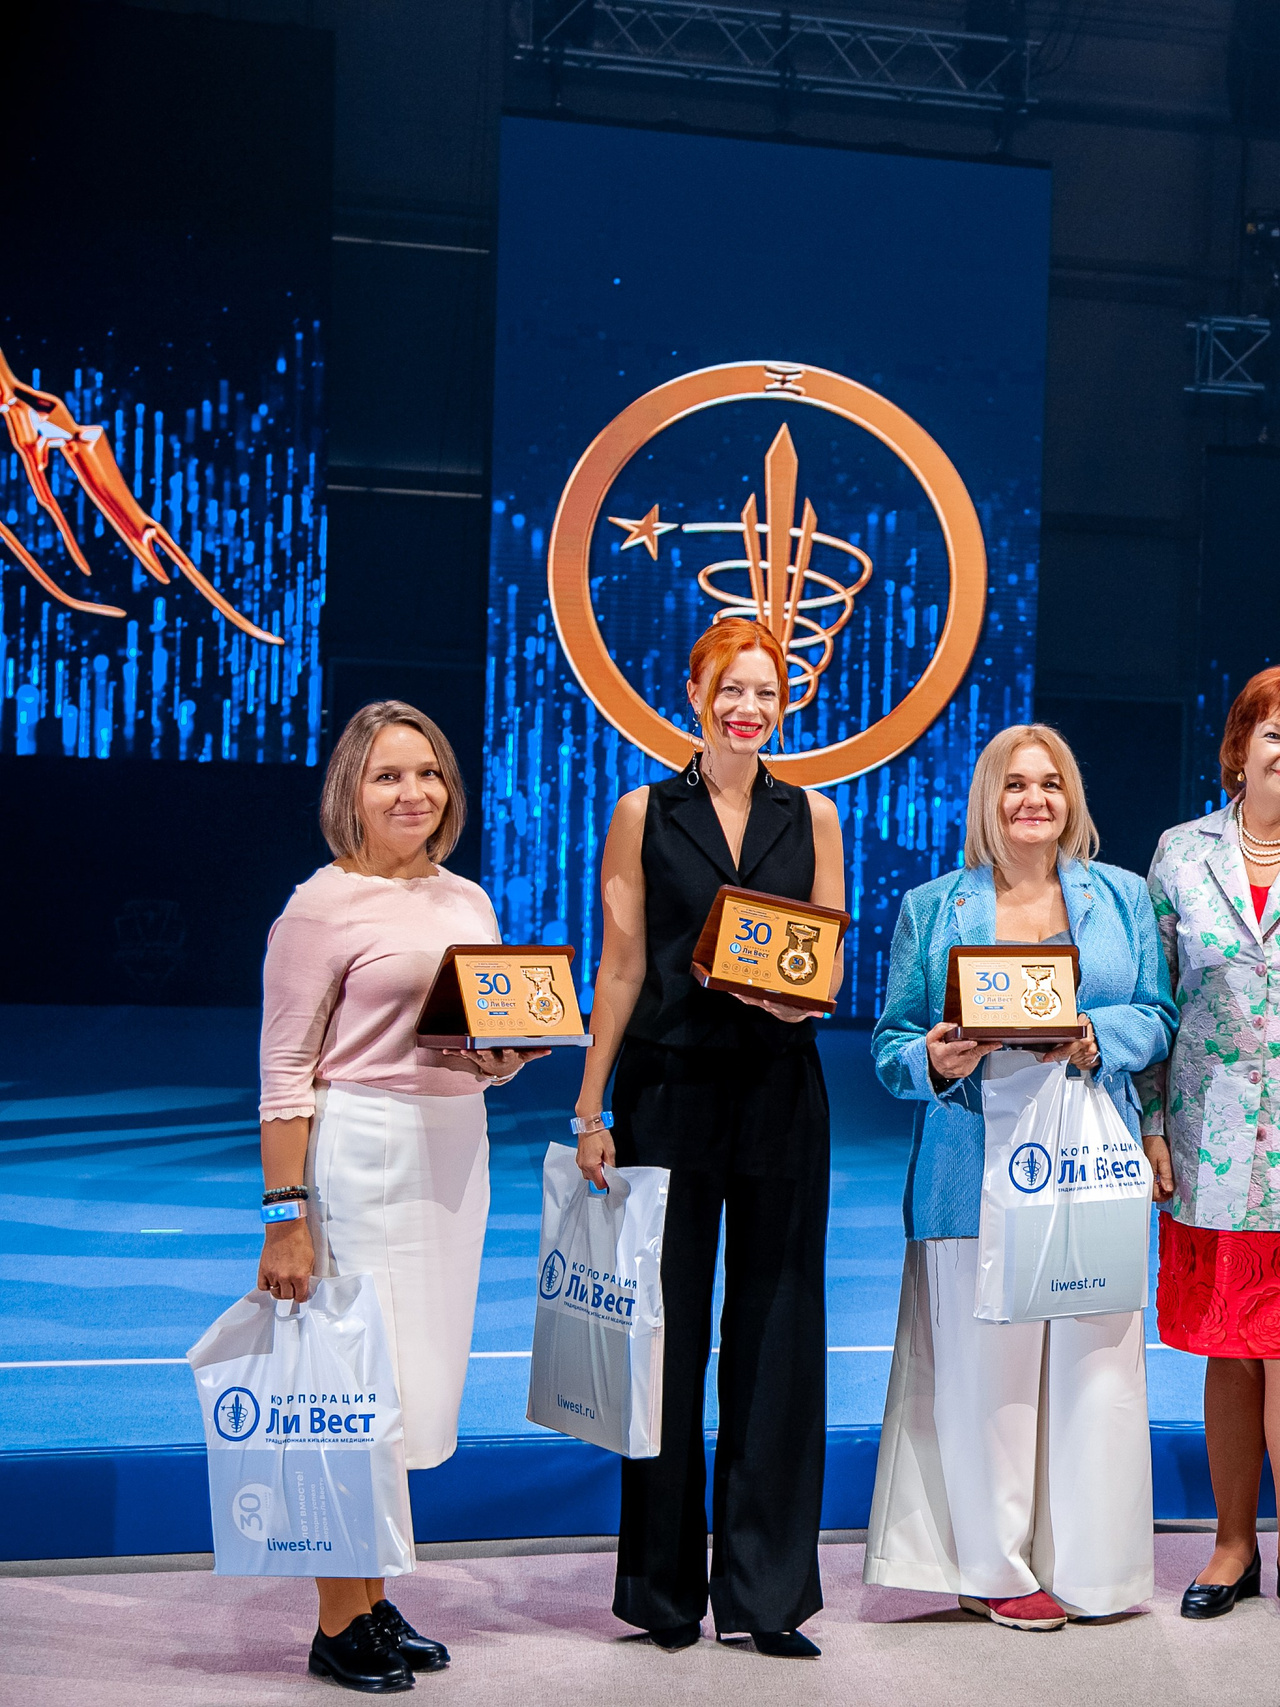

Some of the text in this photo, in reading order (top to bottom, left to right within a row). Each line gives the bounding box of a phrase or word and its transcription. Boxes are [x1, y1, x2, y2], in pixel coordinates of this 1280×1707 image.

[735, 917, 772, 945] 30
[475, 973, 511, 995] 30
[976, 972, 1010, 991] 30
[1051, 1277, 1106, 1292] liwest.ru
[591, 1283, 636, 1317] Вест
[271, 1393, 376, 1405] КОРПОРАЦИЯ
[557, 1393, 595, 1419] liwest.ru
[266, 1407, 376, 1435] Ли Вест
[239, 1493, 263, 1531] 30
[267, 1538, 332, 1551] liwest.ru
